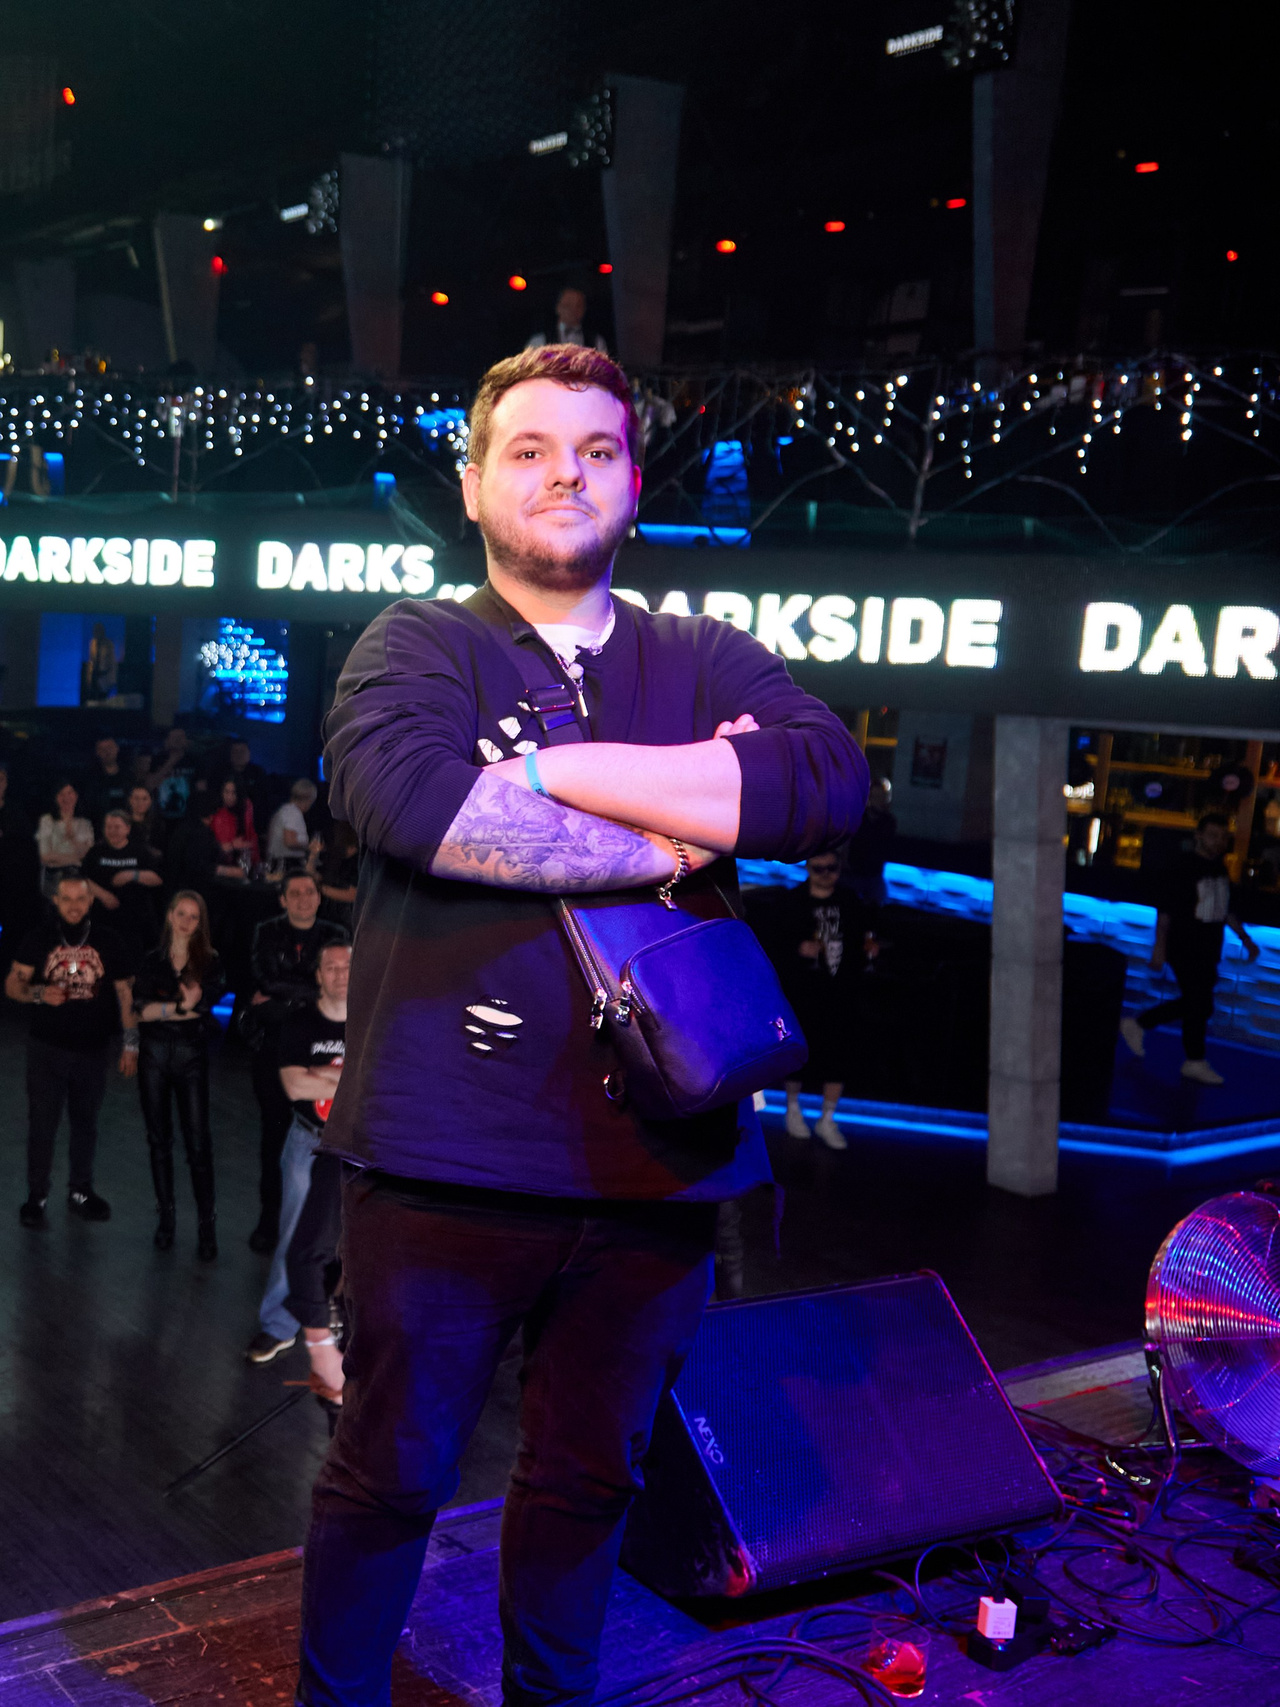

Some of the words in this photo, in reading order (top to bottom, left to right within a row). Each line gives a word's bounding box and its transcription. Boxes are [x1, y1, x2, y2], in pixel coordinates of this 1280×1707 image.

[610, 587, 1004, 670] KSIDE
[1079, 601, 1279, 680] DAR
[693, 1416, 725, 1465] NEXO
